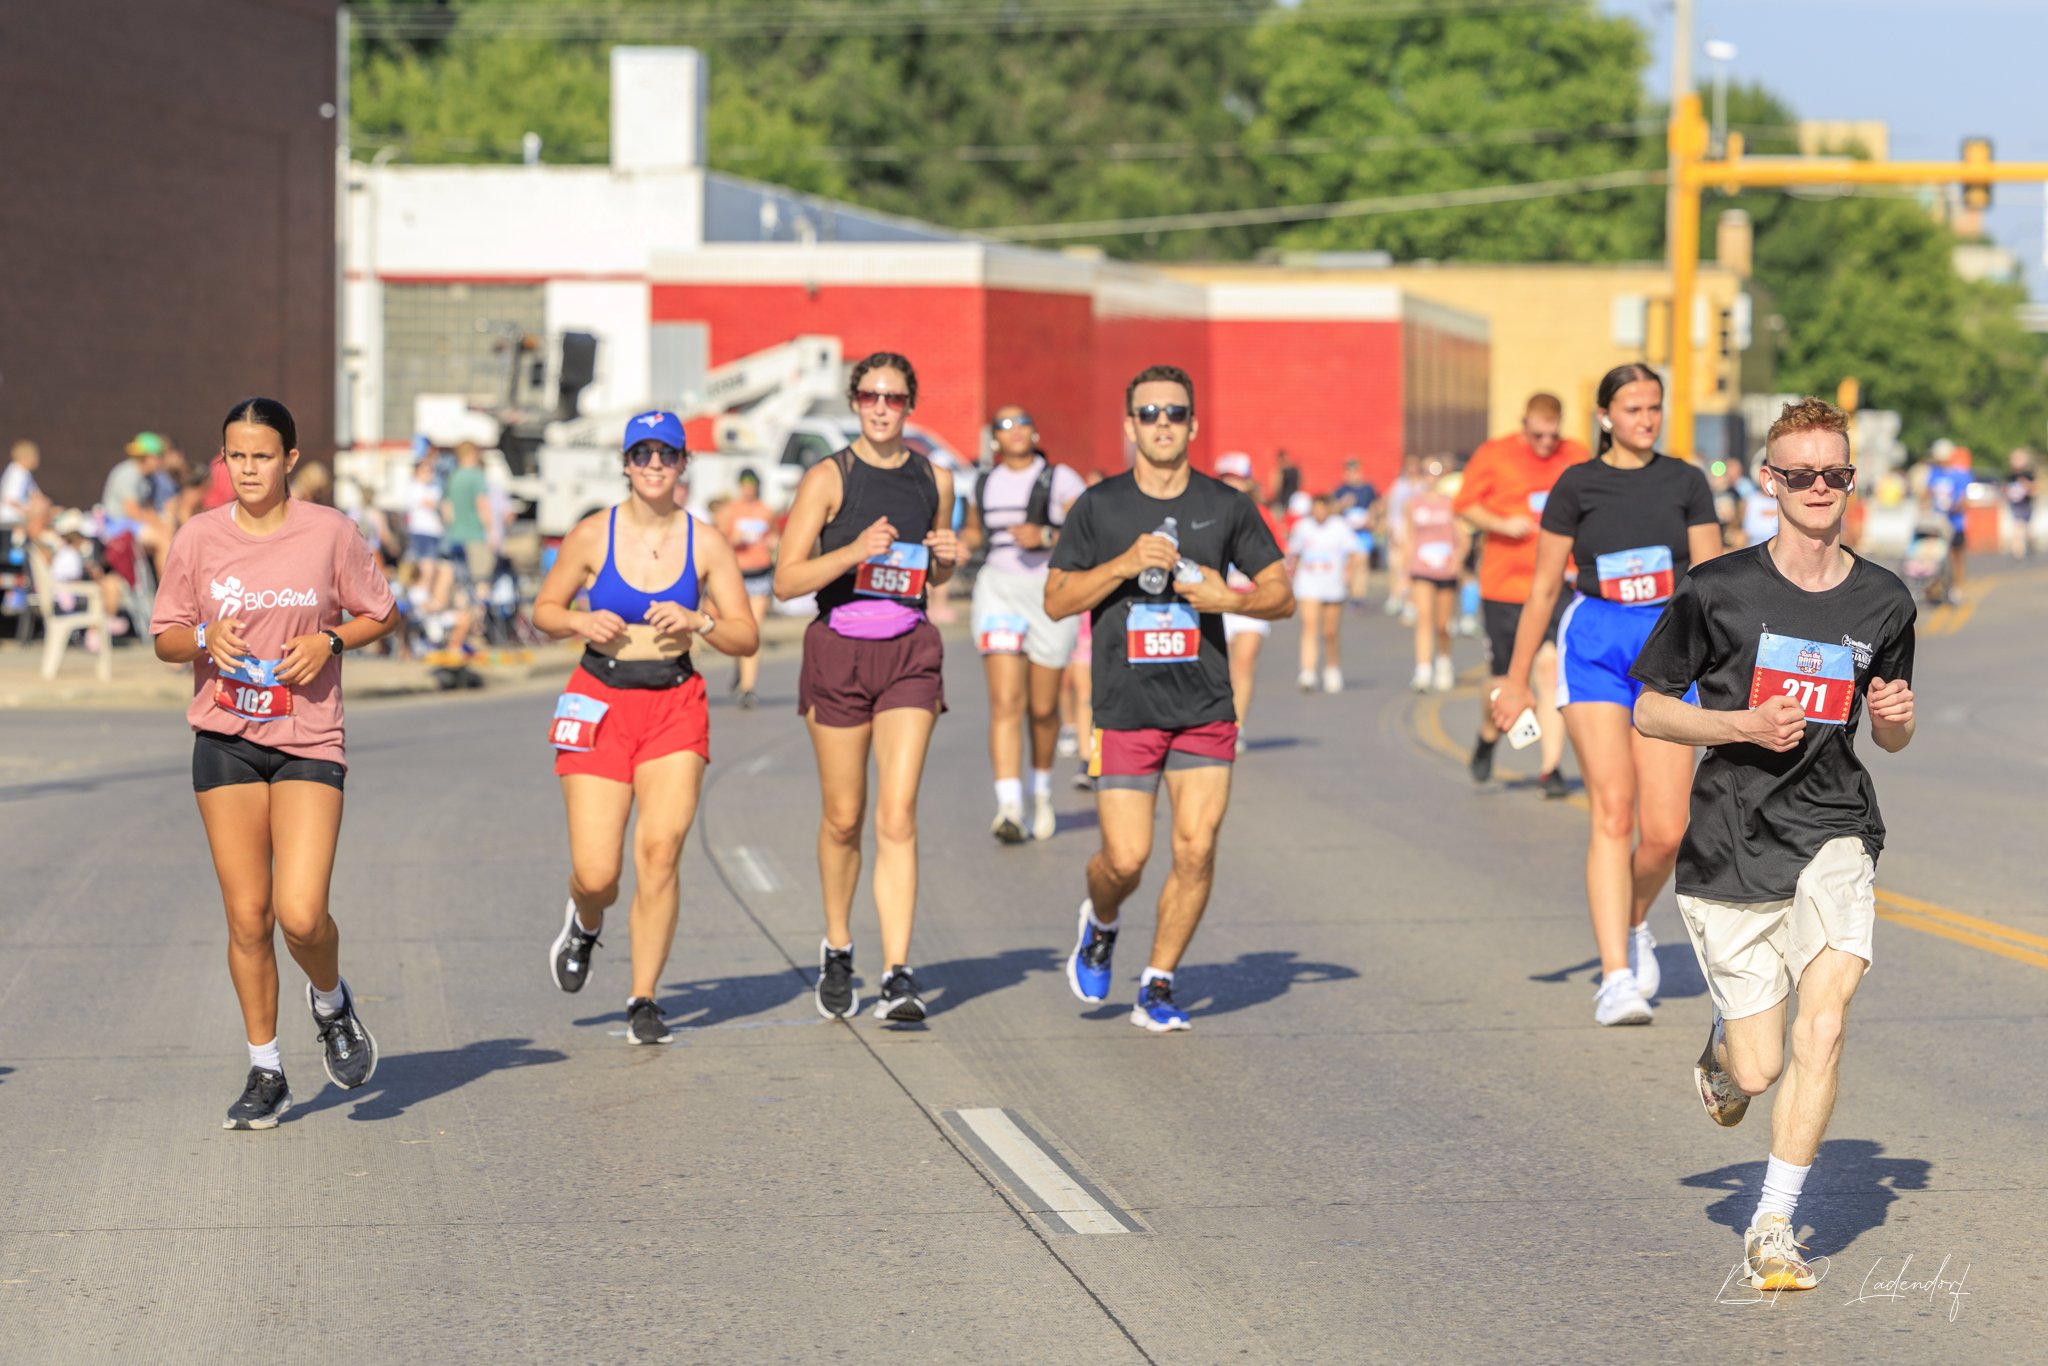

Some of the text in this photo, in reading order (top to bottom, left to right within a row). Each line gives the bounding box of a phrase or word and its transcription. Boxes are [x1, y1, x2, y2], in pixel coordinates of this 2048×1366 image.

[871, 566, 912, 594] 555
[1619, 575, 1657, 602] 513
[244, 587, 319, 611] BIOGirls
[1144, 631, 1186, 656] 556
[236, 686, 274, 715] 102
[1782, 678, 1828, 713] 271
